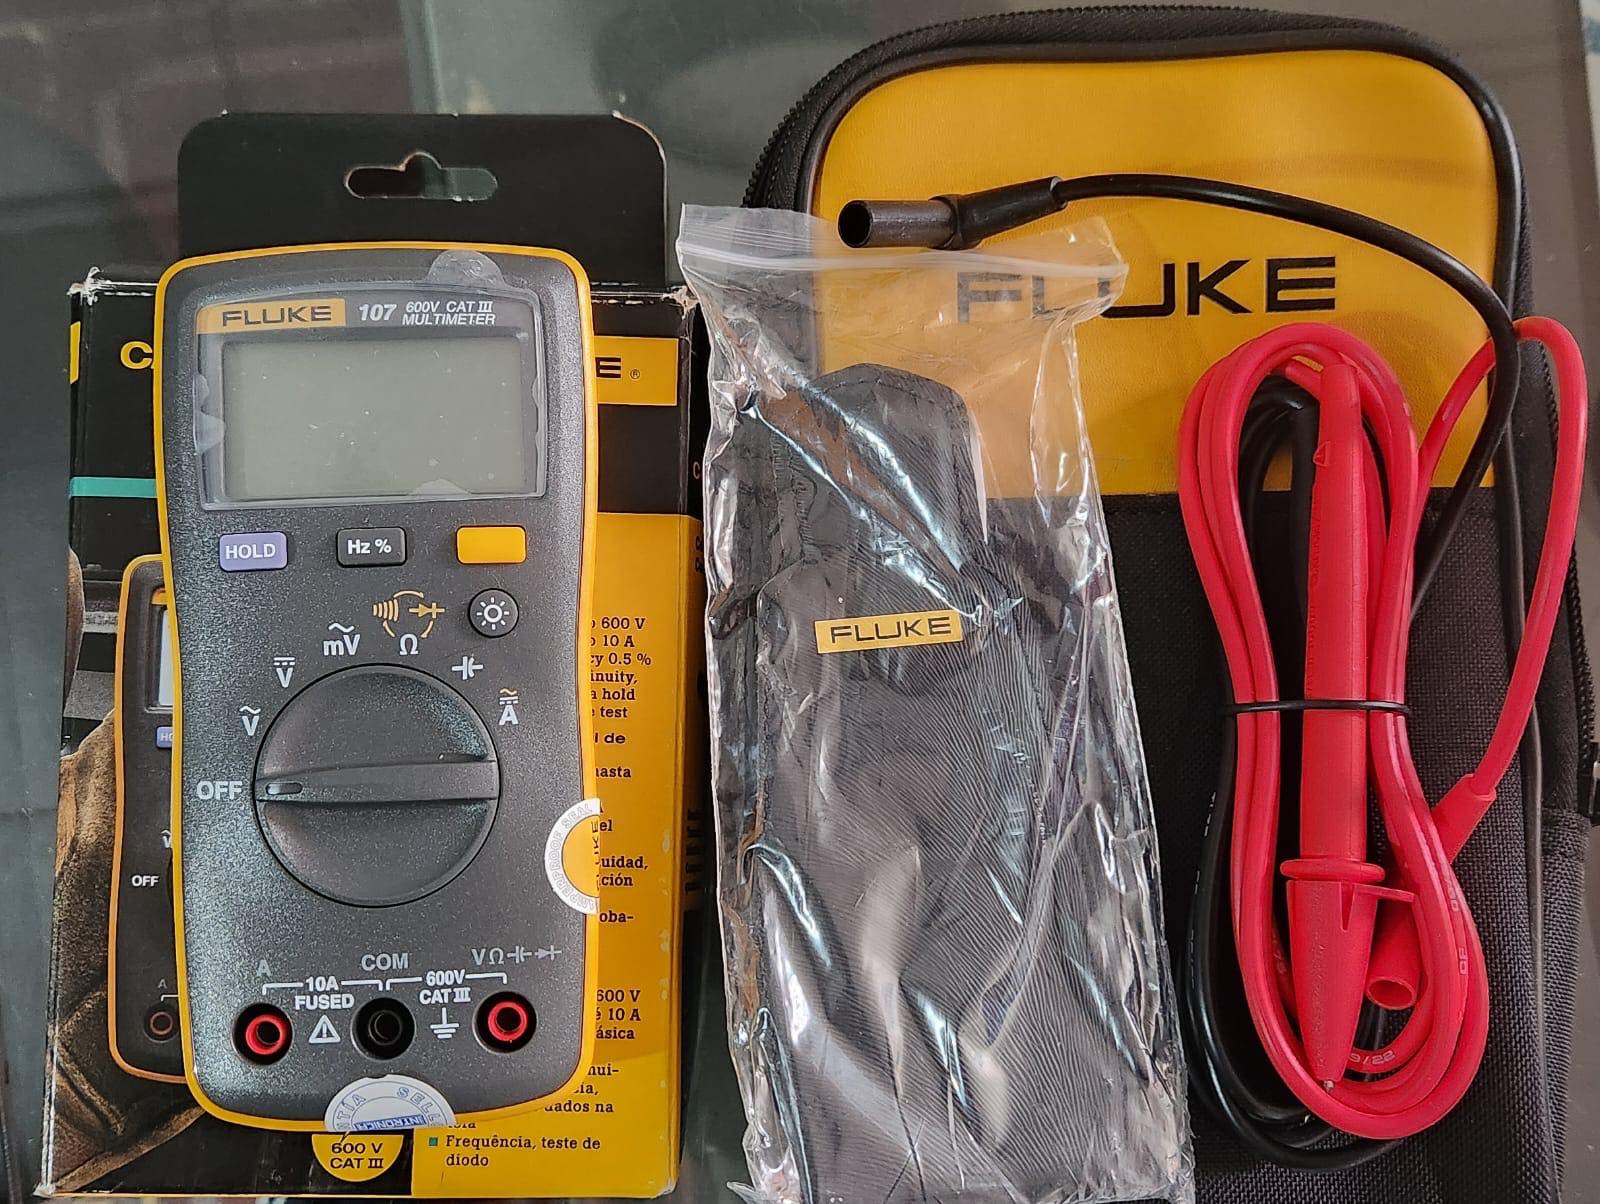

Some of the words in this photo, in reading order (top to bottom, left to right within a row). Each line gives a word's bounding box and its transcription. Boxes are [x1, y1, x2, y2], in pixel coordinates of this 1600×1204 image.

[957, 256, 1336, 323] FLUKE
[222, 305, 332, 327] FLUKE
[358, 303, 397, 321] 107
[406, 301, 440, 313] 600V
[446, 301, 476, 312] CAT
[477, 301, 493, 312] III
[402, 313, 496, 326] MULTIMETER
[225, 543, 276, 560] HOLD
[347, 539, 371, 554] Hz
[375, 539, 392, 554] %
[601, 617, 630, 629] 600
[635, 617, 646, 629] V
[830, 616, 951, 644] FLUKE
[323, 633, 361, 656] mV
[603, 635, 619, 647] 10
[624, 635, 635, 647] A
[608, 652, 632, 665] 0.5
[637, 653, 651, 665] %
[602, 688, 635, 700] hold
[600, 706, 628, 718] test
[604, 733, 626, 744] de
[197, 781, 243, 801] OFF
[131, 875, 160, 887] OFF
[256, 961, 272, 976] A
[361, 953, 409, 971] COM
[305, 976, 339, 991] 10A
[426, 970, 466, 986] 600V
[295, 994, 354, 1010] FUSED
[420, 989, 452, 1004] CAT
[453, 987, 471, 1003] III
[630, 990, 641, 1002] V
[608, 1008, 625, 1020] 10
[630, 1008, 641, 1021] A
[595, 1103, 614, 1113] na
[331, 1143, 366, 1155] 600
[370, 1143, 384, 1154] V
[446, 1134, 537, 1150] Frequência,
[541, 1137, 578, 1150] teste
[582, 1137, 601, 1150] de
[329, 1158, 365, 1170] CAT
[367, 1158, 384, 1169] III
